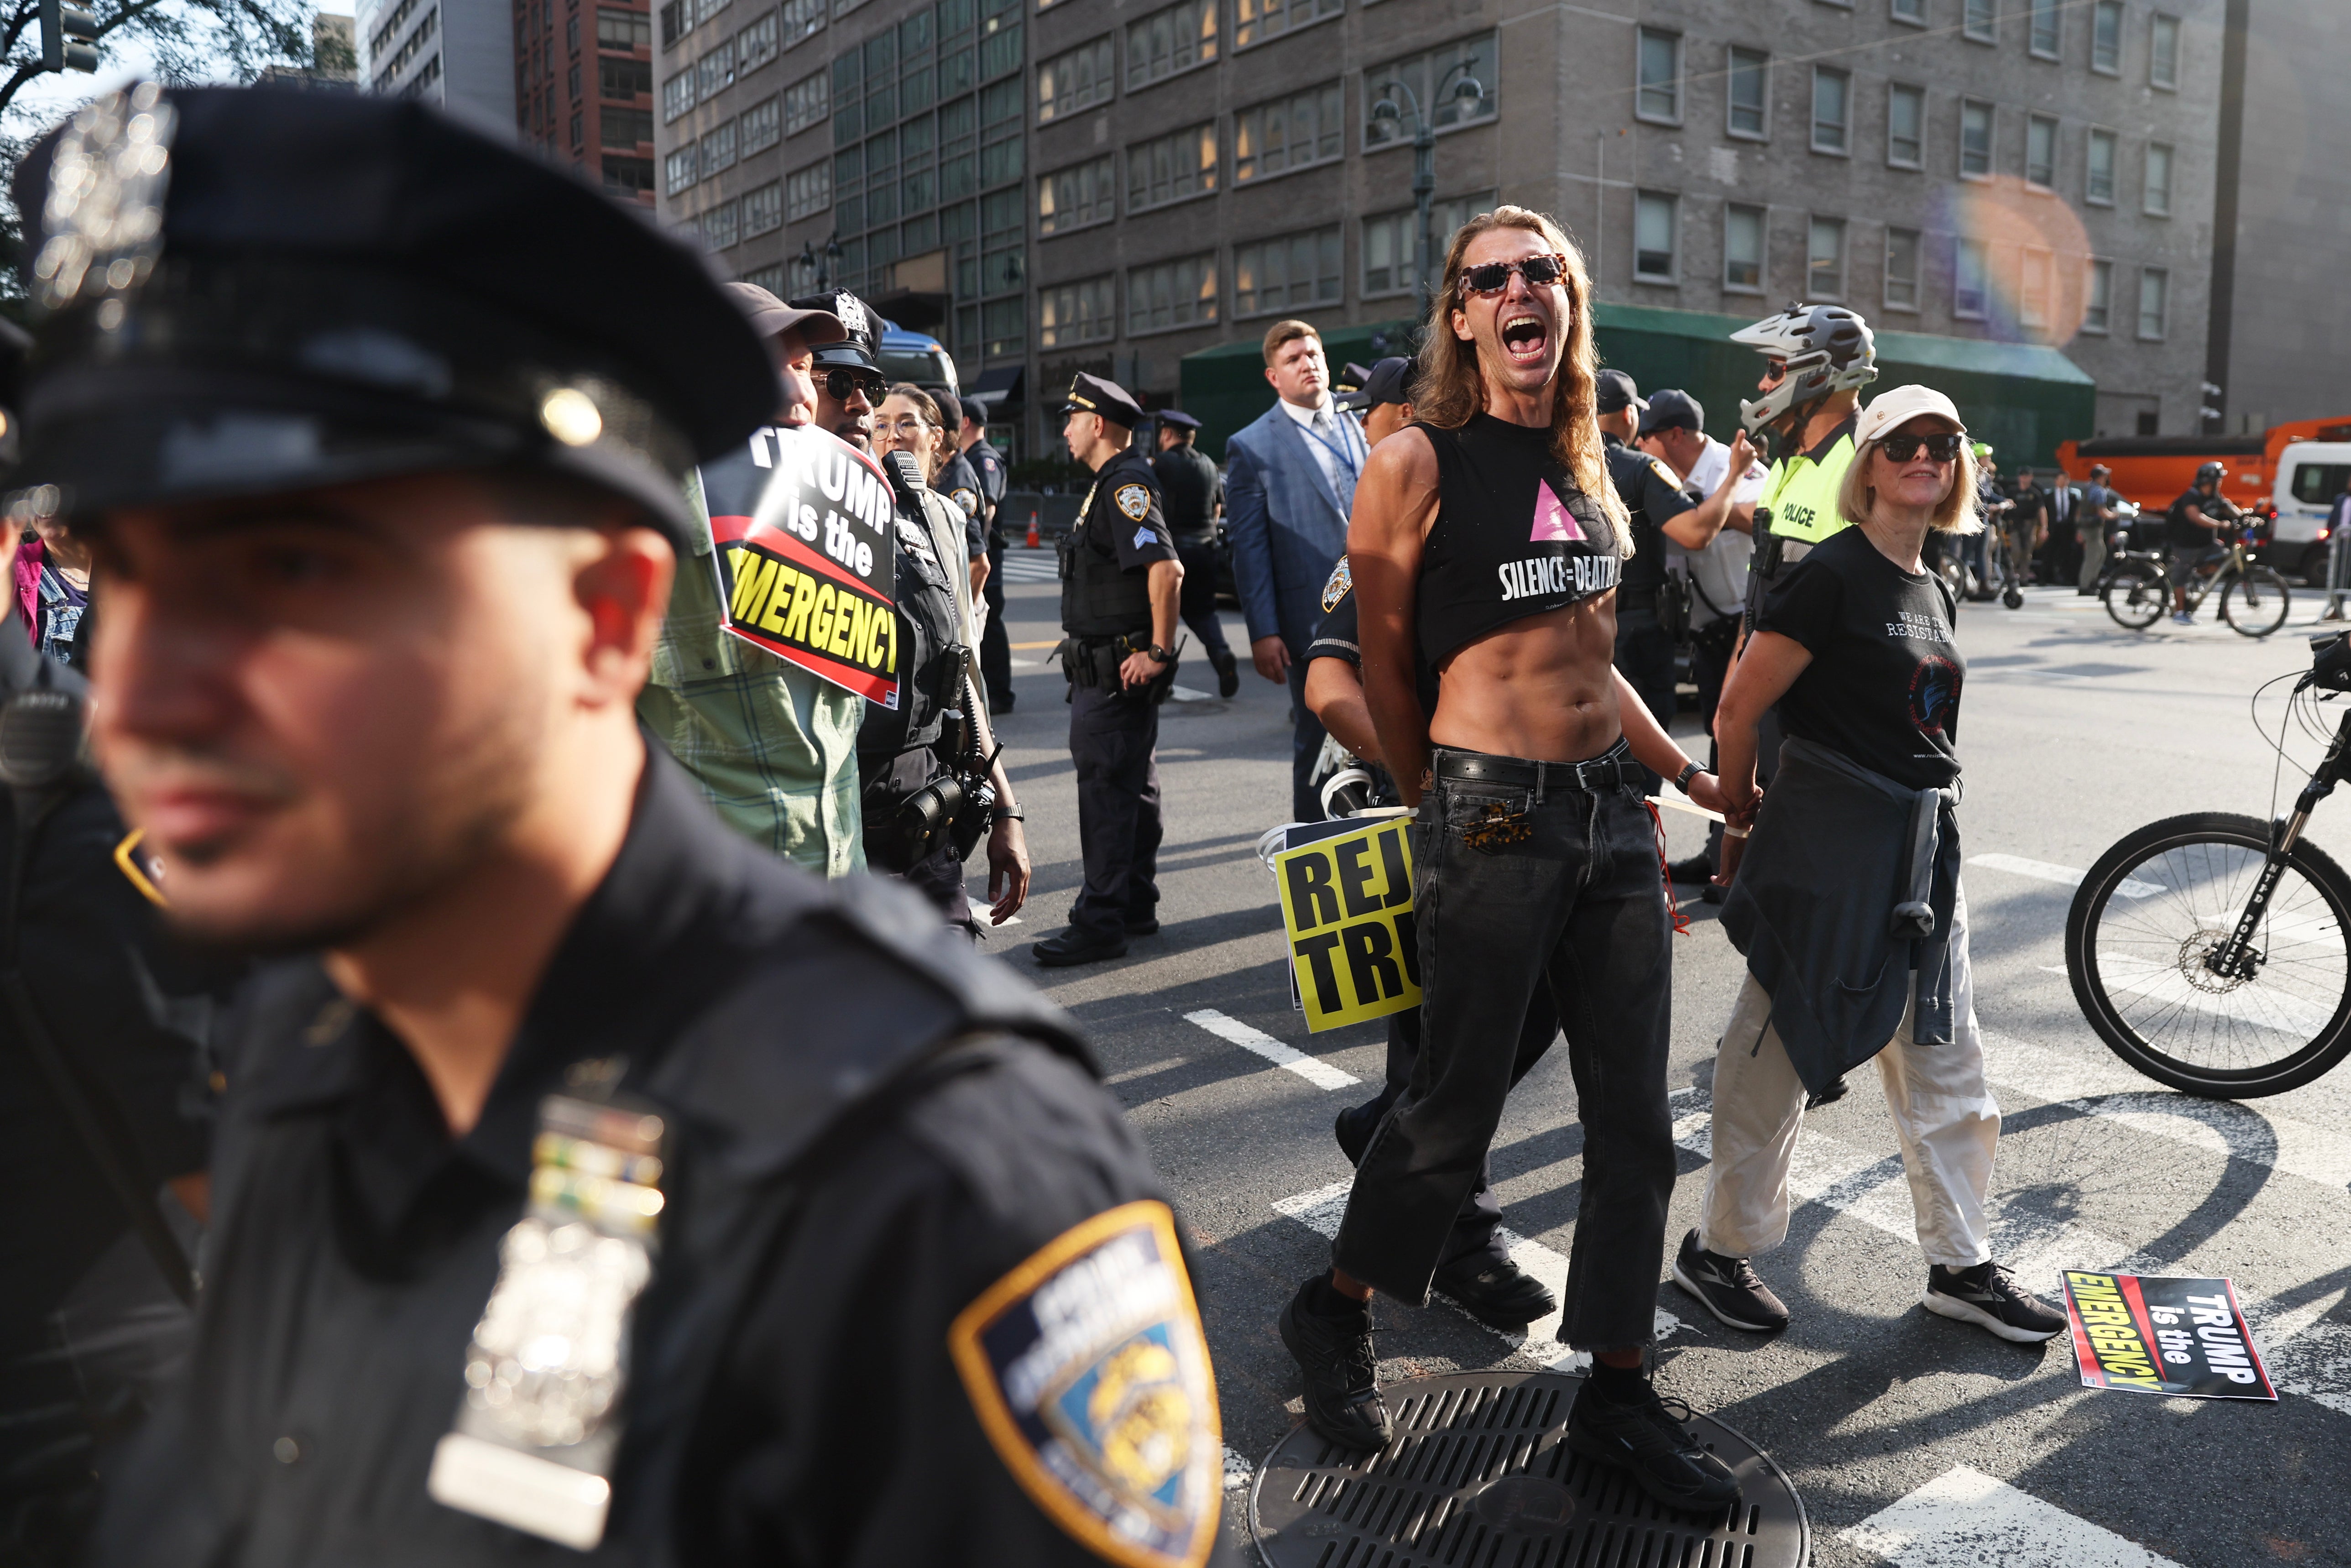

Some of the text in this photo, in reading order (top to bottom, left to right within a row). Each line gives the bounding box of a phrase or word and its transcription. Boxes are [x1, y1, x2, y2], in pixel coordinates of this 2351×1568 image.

[749, 425, 891, 535] TRUMP
[1781, 502, 1816, 528] POLICE
[787, 485, 872, 577] is the
[726, 547, 896, 674] MERGENCY
[1332, 577, 1352, 603] NEW YO
[1886, 623, 1958, 647] RESISTAN
[1898, 612, 1912, 622] WE
[1915, 614, 1930, 626] ARE
[1931, 655, 1959, 676] PROJECT
[1285, 824, 1413, 932] REJ
[2219, 862, 2279, 973] NYPD POLICE
[2067, 1272, 2163, 1391] EMERGENCY
[2149, 1306, 2194, 1364] is the
[2187, 1294, 2257, 1384] TRUMP
